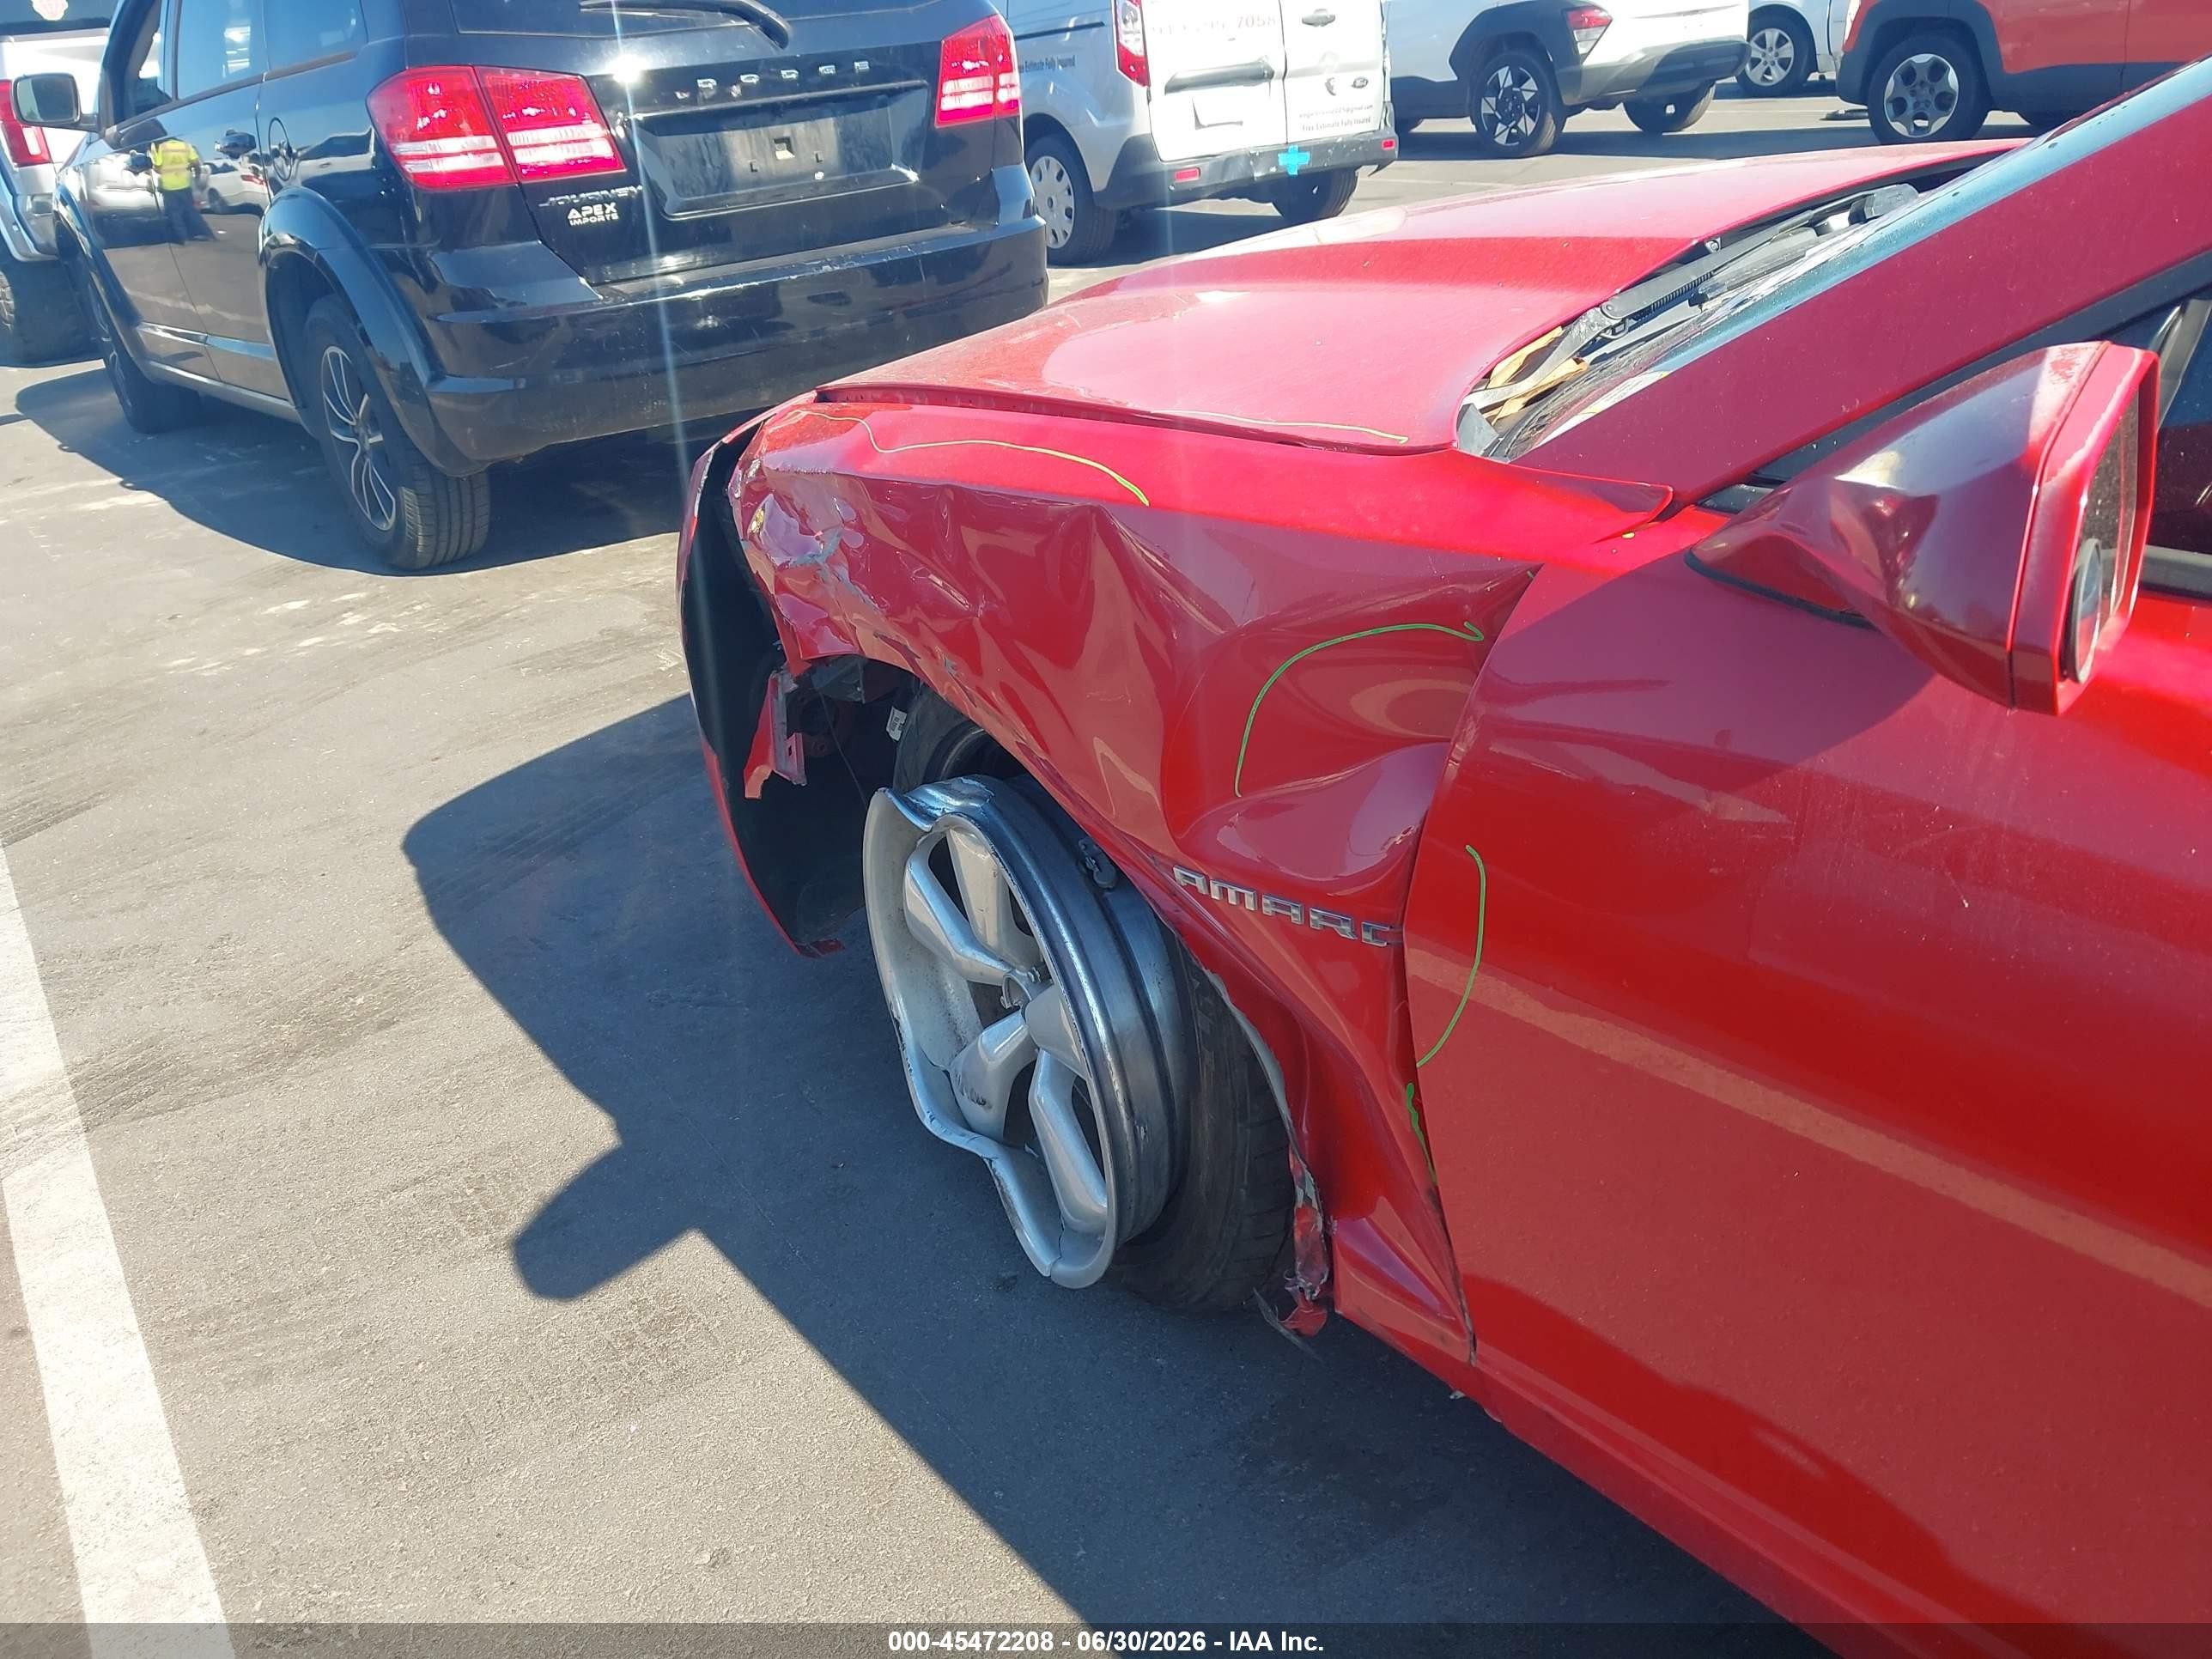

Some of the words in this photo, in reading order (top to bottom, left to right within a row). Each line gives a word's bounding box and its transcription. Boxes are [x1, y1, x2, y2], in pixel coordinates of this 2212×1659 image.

[696, 60, 870, 89] DODGE
[538, 185, 643, 207] JOURNEY
[567, 202, 617, 220] APEX
[568, 212, 619, 227] IMPORTS
